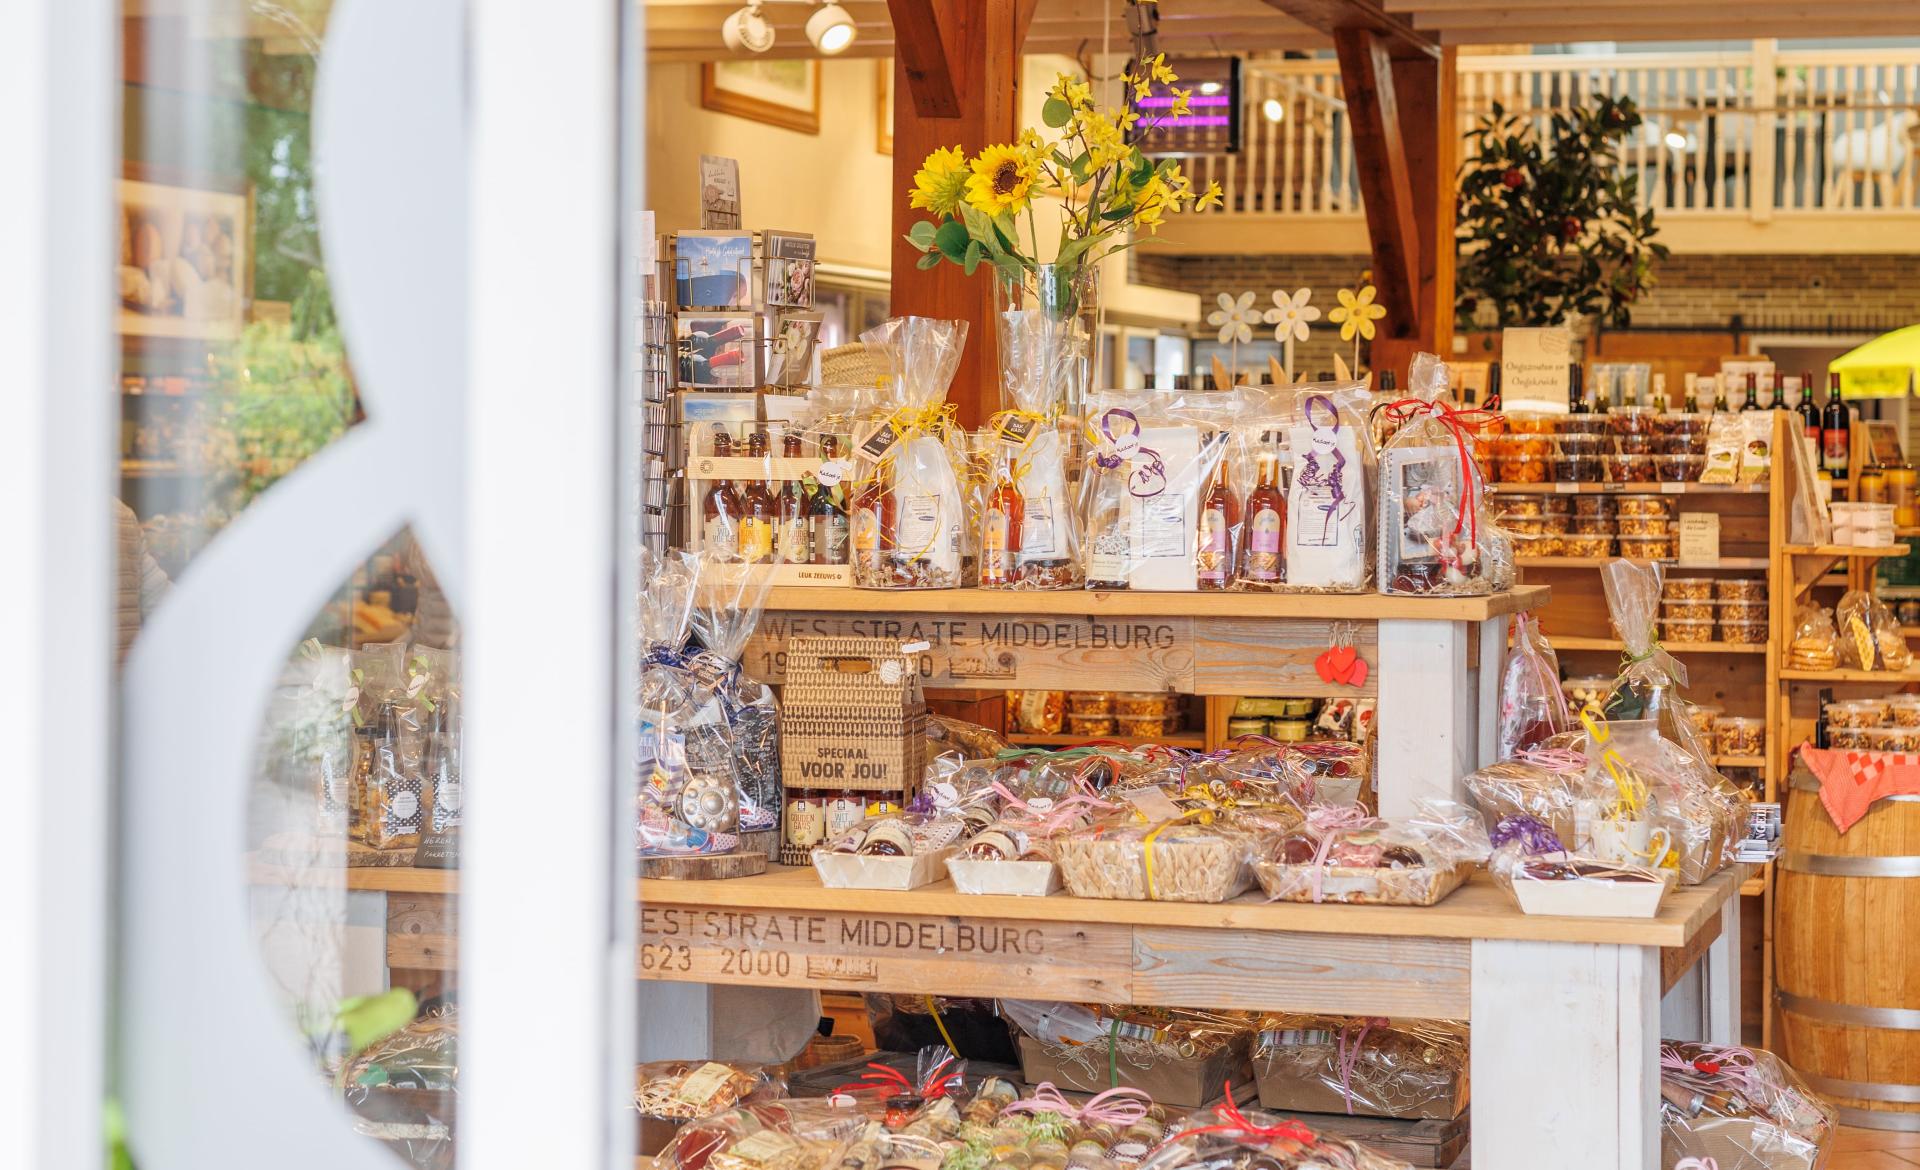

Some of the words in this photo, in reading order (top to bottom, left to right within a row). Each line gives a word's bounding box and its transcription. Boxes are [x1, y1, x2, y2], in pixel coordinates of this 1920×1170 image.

[798, 571, 812, 579] LEUK
[981, 621, 1175, 650] MIDDELBURG
[761, 652, 787, 677] 19
[817, 747, 869, 760] SPECIAAL
[800, 761, 845, 779] VOOR
[851, 763, 888, 780] JOU!
[640, 908, 827, 945] ESTSTRATE
[841, 918, 1046, 956] MIDDELBURG
[640, 943, 693, 973] 623
[721, 947, 790, 977] 2000
